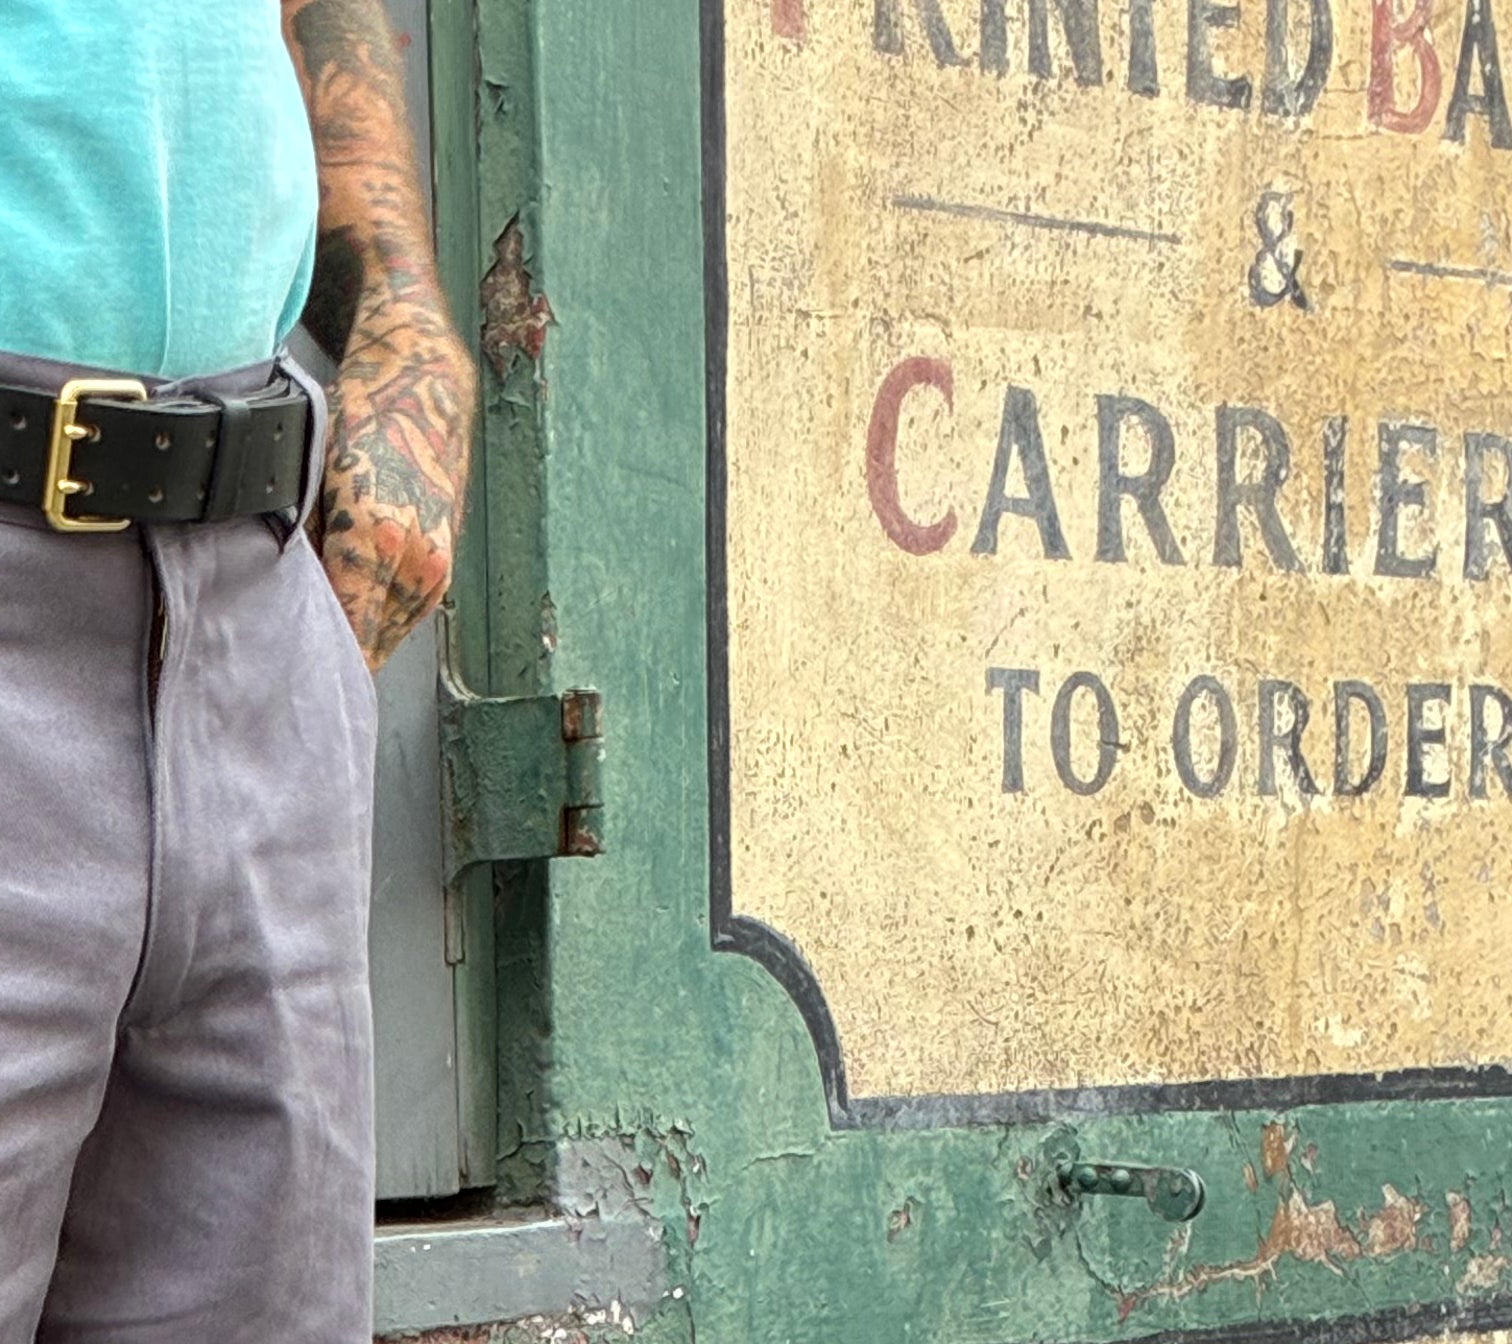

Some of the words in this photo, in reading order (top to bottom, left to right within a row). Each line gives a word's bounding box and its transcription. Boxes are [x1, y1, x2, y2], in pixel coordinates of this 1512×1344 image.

[771, 0, 1333, 119] NTED
[1248, 191, 1315, 312] &
[985, 667, 1123, 796] TO
